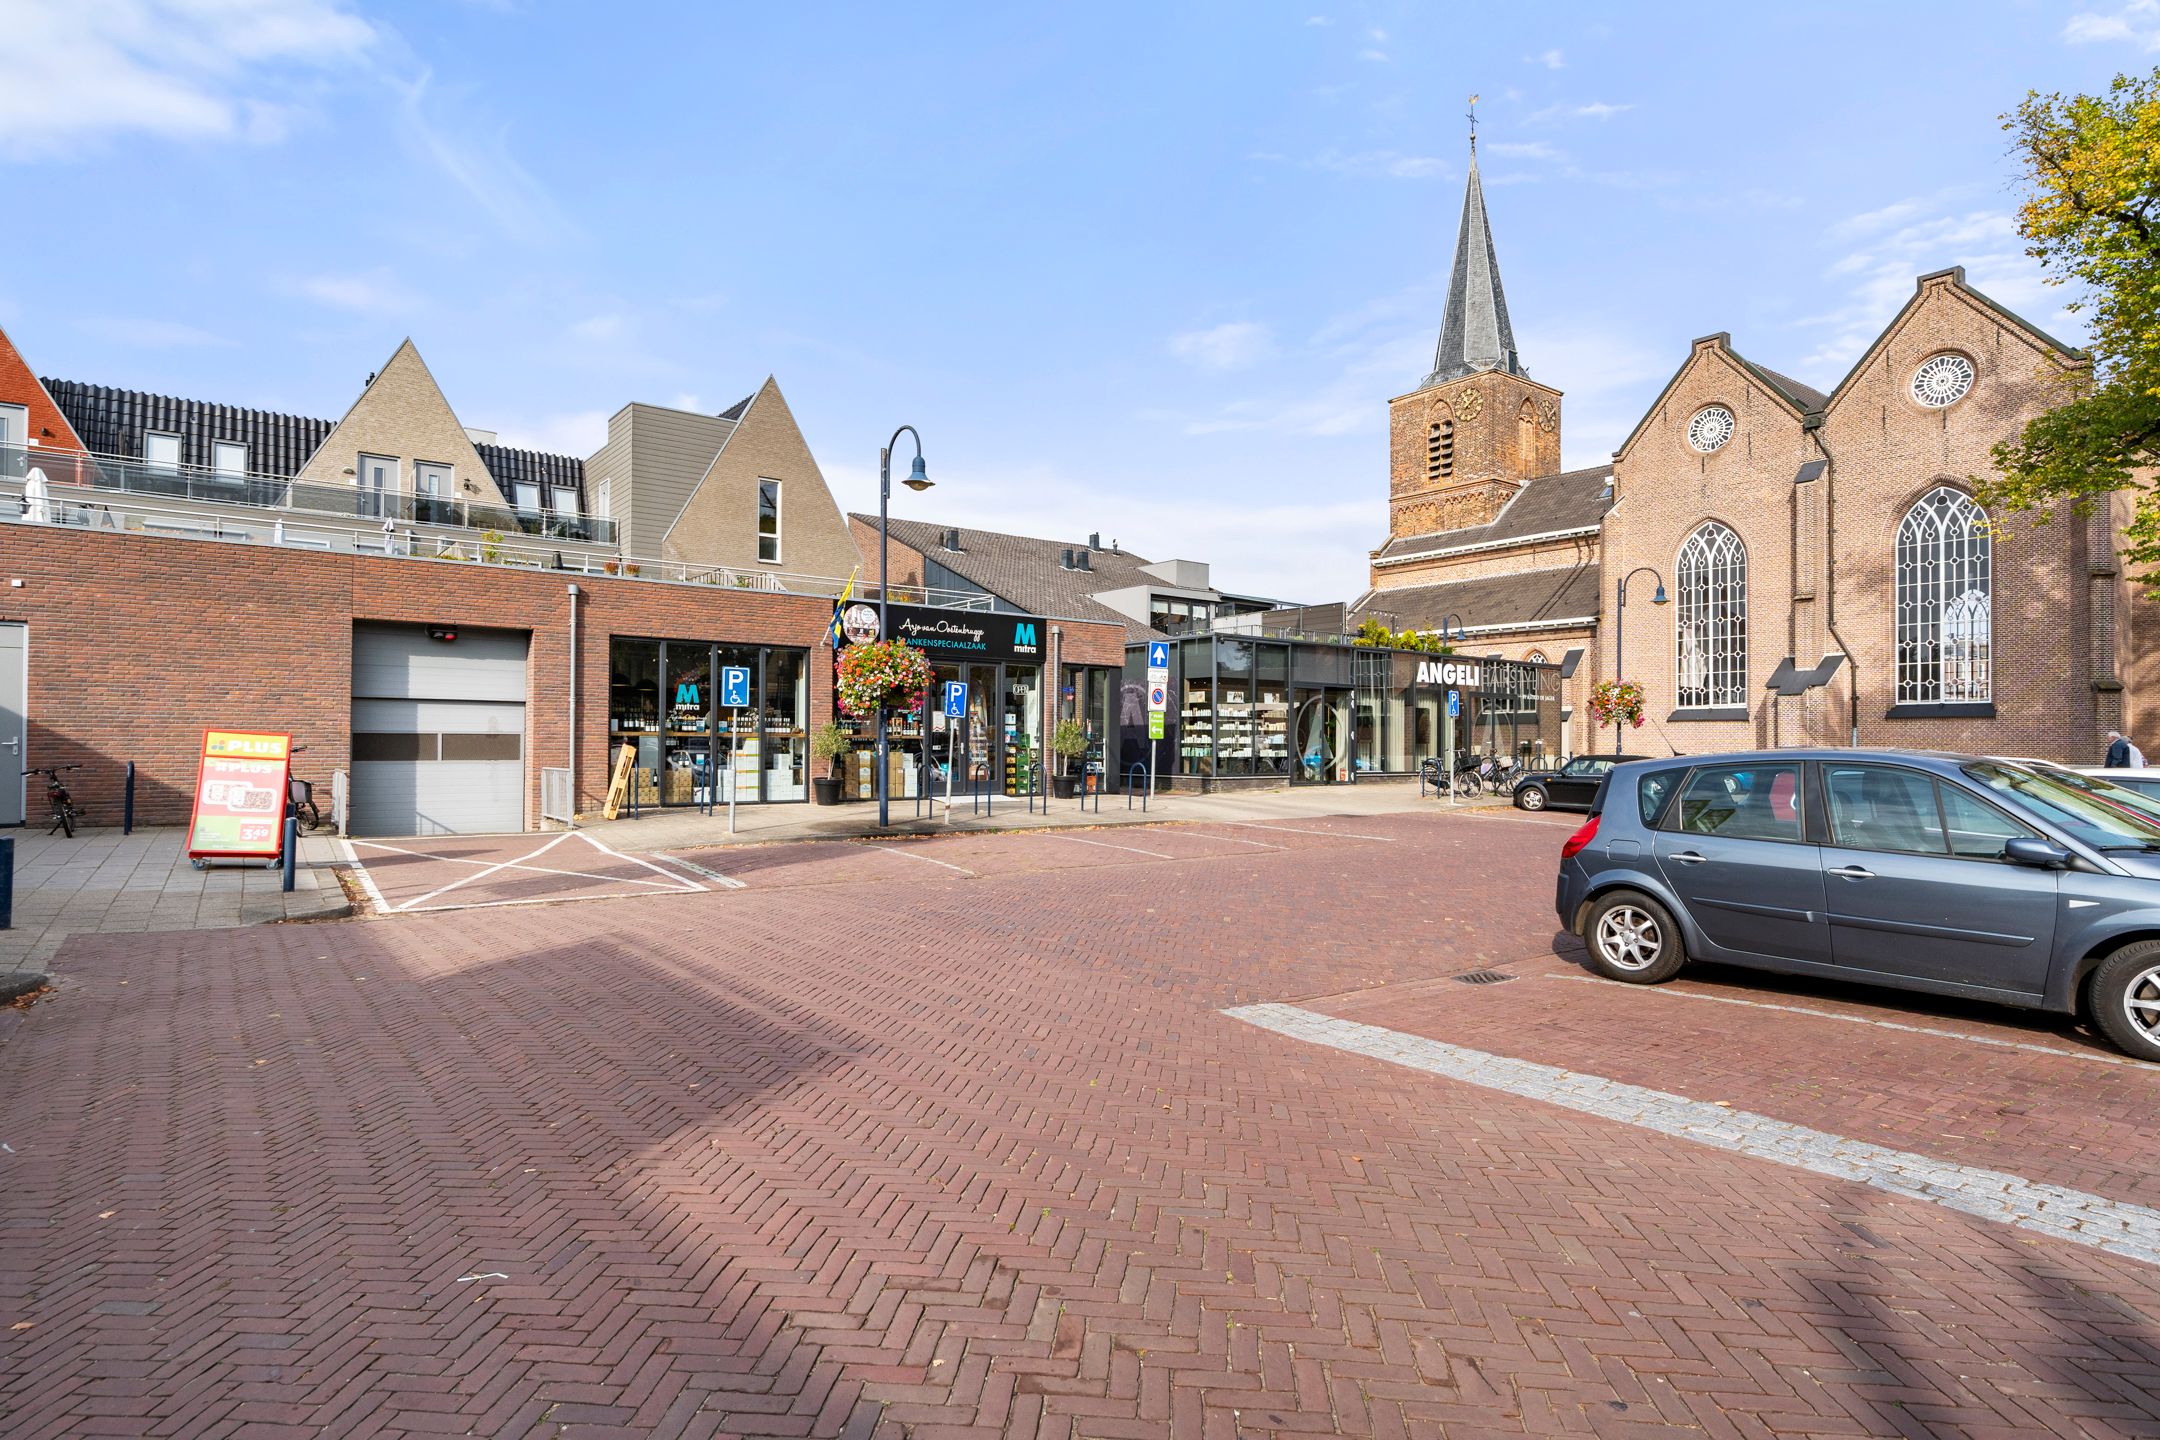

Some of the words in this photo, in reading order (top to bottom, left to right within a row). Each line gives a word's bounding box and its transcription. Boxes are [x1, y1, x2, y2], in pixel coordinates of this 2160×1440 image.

[936, 620, 985, 643] Oostenbrugge
[896, 635, 986, 650] ANKENSPECIAALZAAK
[1014, 645, 1037, 653] mitra
[728, 670, 744, 691] P
[1416, 661, 1480, 686] ANGELI
[1481, 666, 1561, 692] HAIRSTYLING
[950, 684, 963, 703] P
[1451, 693, 1458, 706] P
[676, 703, 700, 711] mitra
[227, 740, 282, 753] PLUS
[228, 762, 272, 774] PLUS
